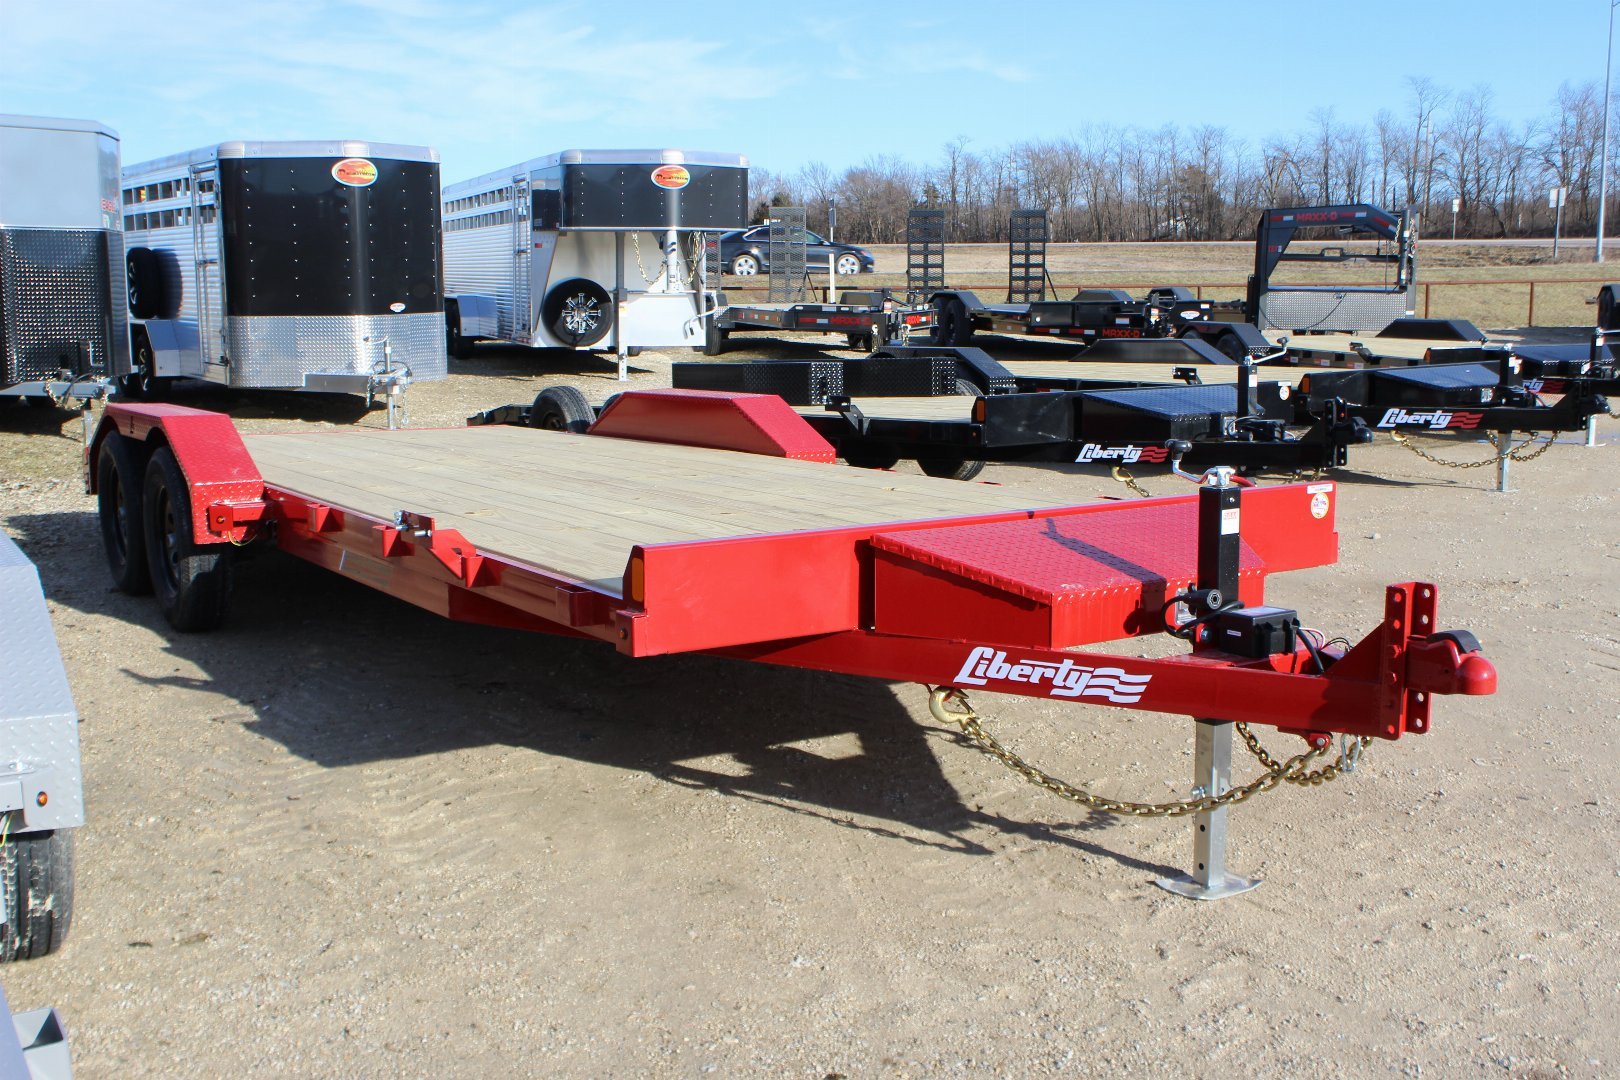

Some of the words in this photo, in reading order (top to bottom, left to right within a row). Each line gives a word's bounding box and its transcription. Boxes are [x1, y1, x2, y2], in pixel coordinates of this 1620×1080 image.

[1376, 408, 1453, 429] Liberty
[1075, 443, 1144, 464] Liberty
[953, 646, 1094, 697] Liberty
